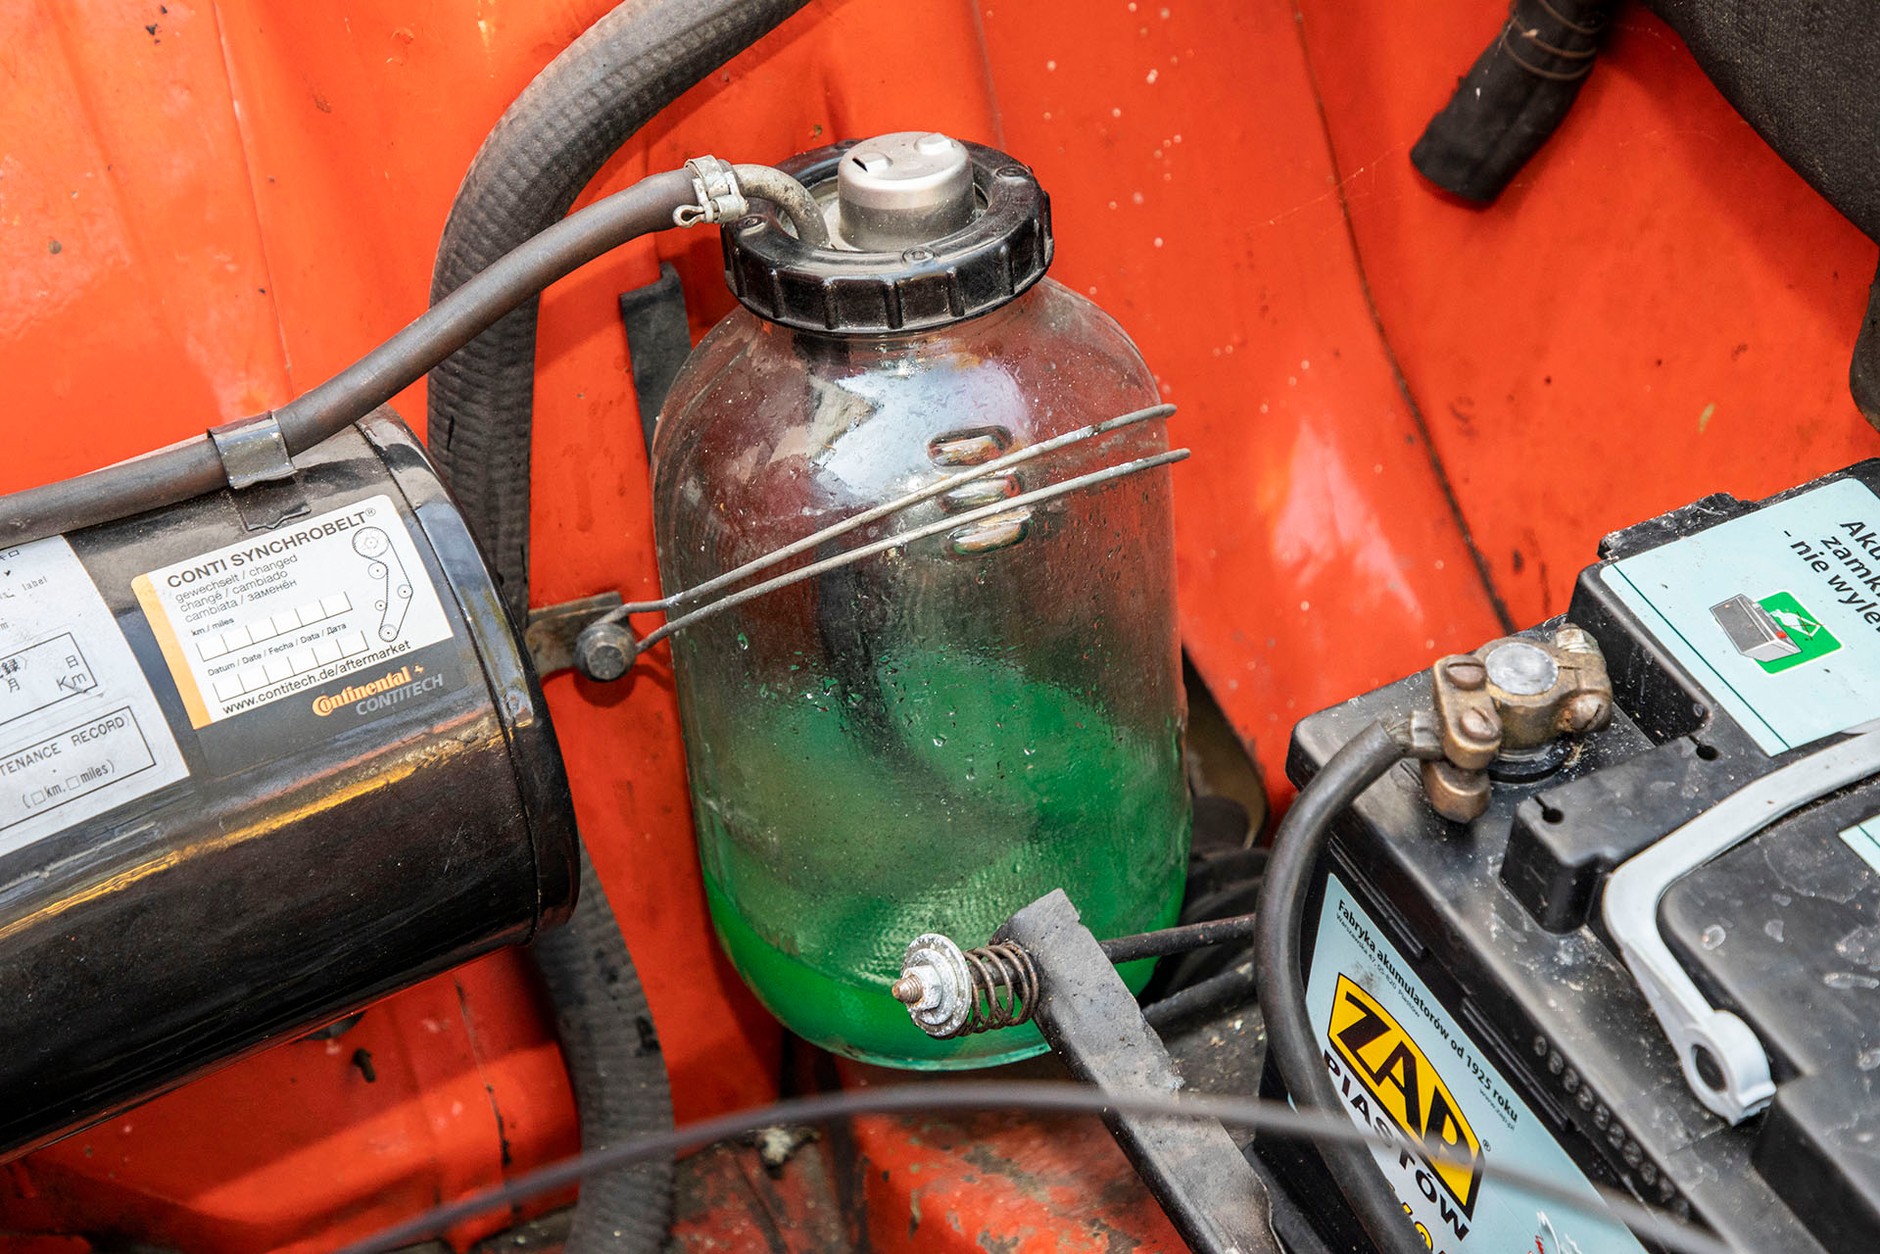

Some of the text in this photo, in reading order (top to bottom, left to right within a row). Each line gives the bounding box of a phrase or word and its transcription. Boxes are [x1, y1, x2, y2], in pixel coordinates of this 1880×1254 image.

[21, 575, 48, 591] label
[167, 558, 228, 589] CONTI
[175, 572, 239, 604] gewechselt
[249, 554, 298, 578] changed
[1790, 540, 1830, 573] nie
[1827, 574, 1880, 633] wyle
[1820, 536, 1880, 598] zamk
[180, 589, 223, 613] changé
[232, 569, 288, 595] cambiado
[185, 597, 238, 623] cambiata
[247, 578, 297, 602] заменён
[191, 627, 206, 637] km
[212, 617, 235, 630] miles
[207, 661, 235, 676] Datum
[241, 652, 262, 665] Date
[268, 641, 294, 655] Fecha
[300, 632, 320, 644] Data
[326, 622, 347, 636] Дата
[8, 654, 79, 693] 月 日
[56, 672, 87, 691] Km
[222, 639, 412, 714] www.contitech.de/aftermarket
[312, 665, 412, 717] Continental
[355, 673, 444, 716] CONTITECH
[1337, 899, 1518, 1123] Fabryka akumulatorów od 1925 roku
[1337, 991, 1474, 1165] ZAP
